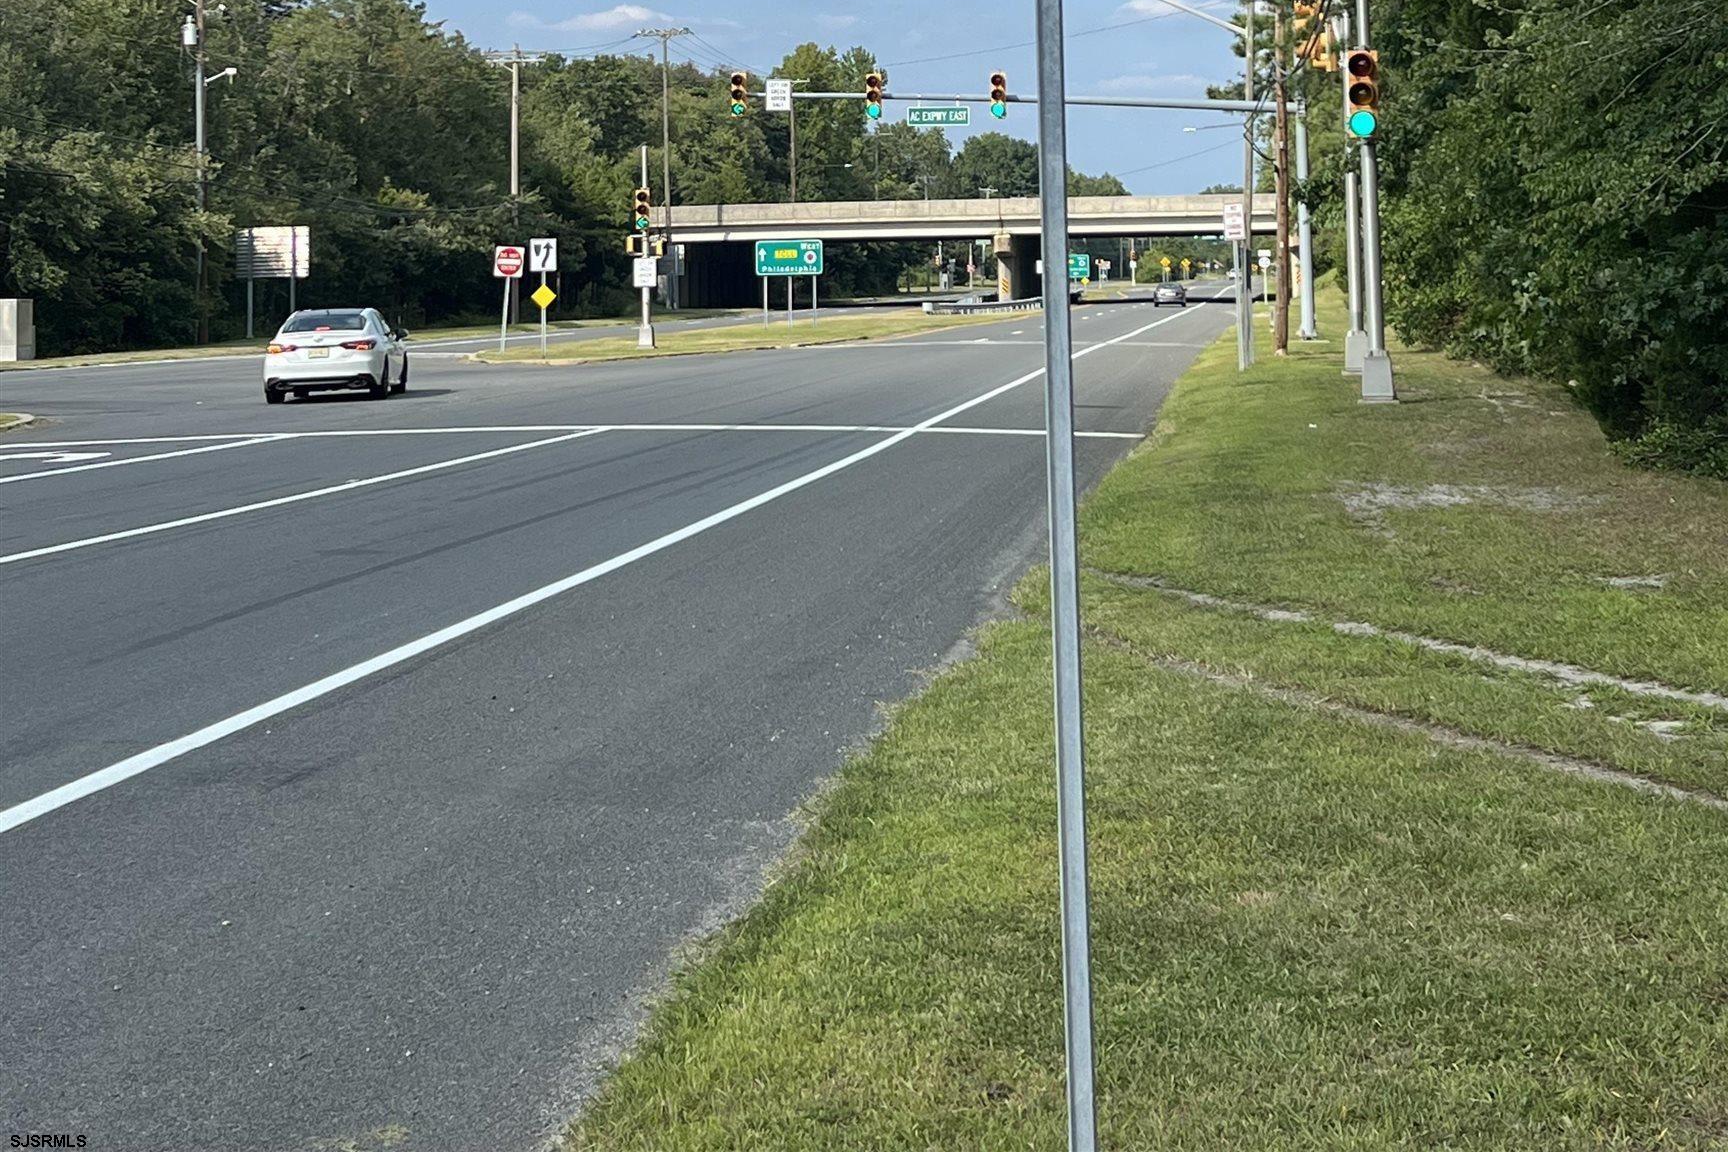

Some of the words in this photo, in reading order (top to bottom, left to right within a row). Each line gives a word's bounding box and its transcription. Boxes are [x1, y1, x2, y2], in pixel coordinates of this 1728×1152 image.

[910, 111, 920, 121] AC
[949, 110, 967, 121] EAST
[761, 265, 817, 273] Philadelphia
